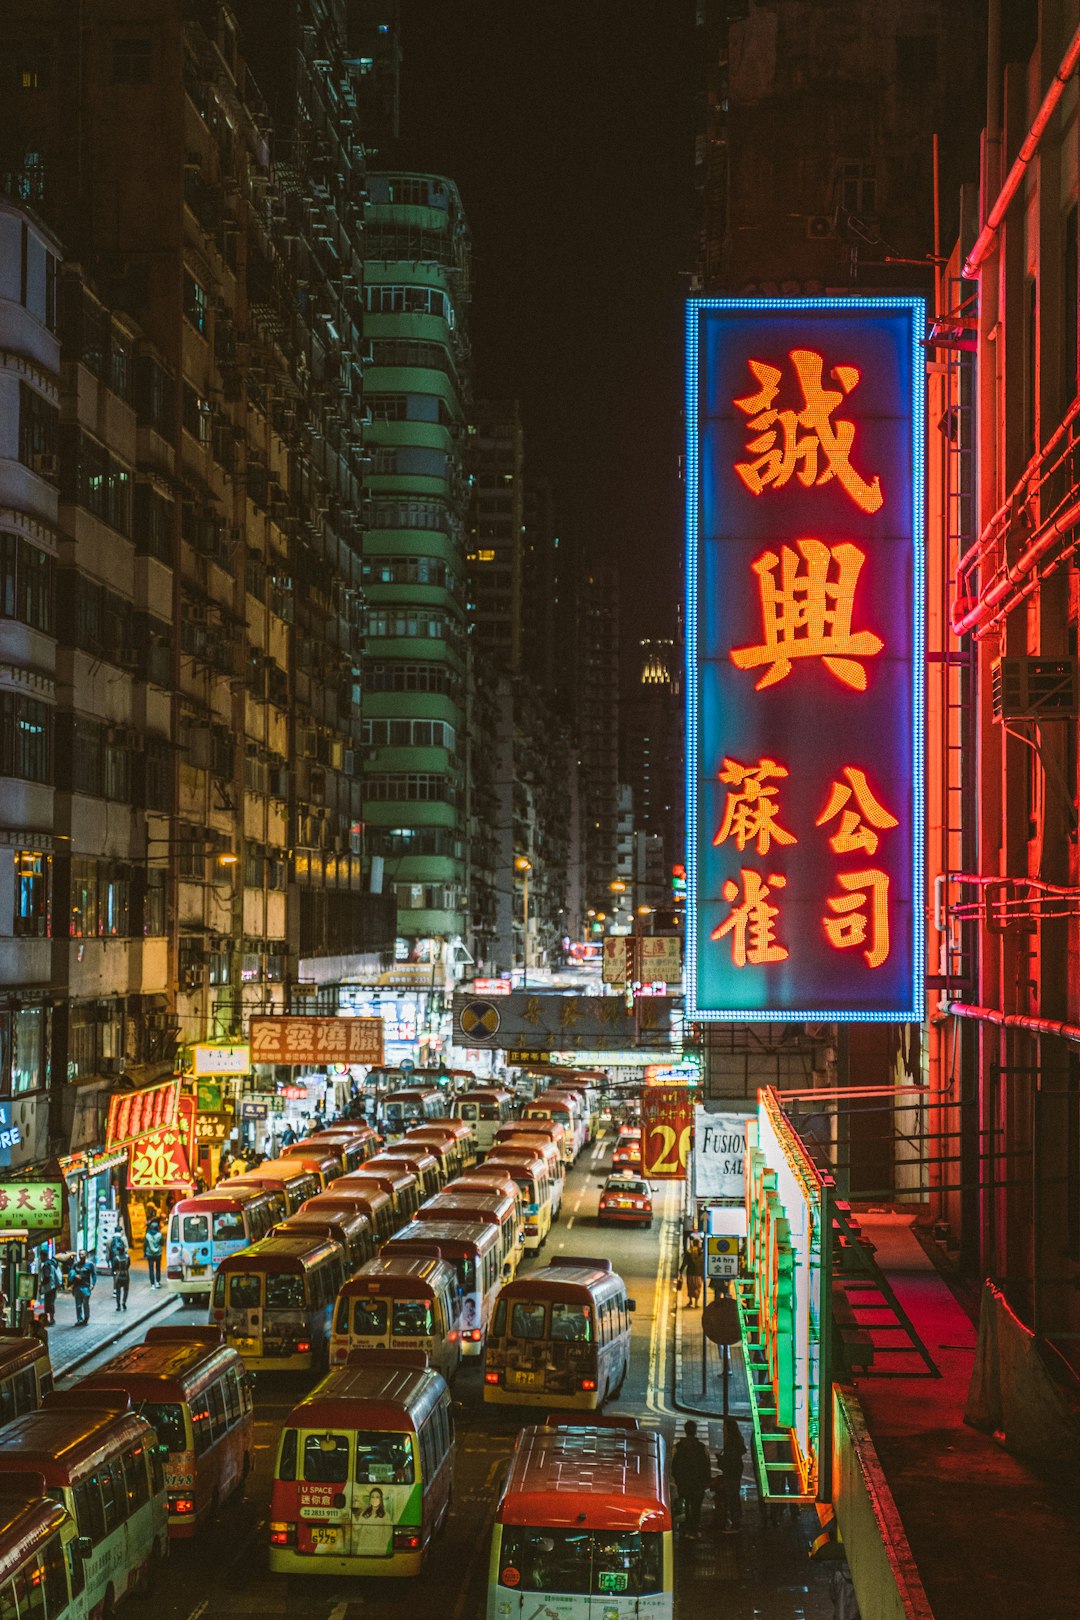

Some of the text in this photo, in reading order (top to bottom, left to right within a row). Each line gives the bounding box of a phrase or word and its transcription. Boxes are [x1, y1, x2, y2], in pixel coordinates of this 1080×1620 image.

[816, 766, 899, 968] 公司
[140, 1156, 169, 1178] 20
[711, 1256, 735, 1264] 24 hrs
[310, 1486, 333, 1494] SPACE
